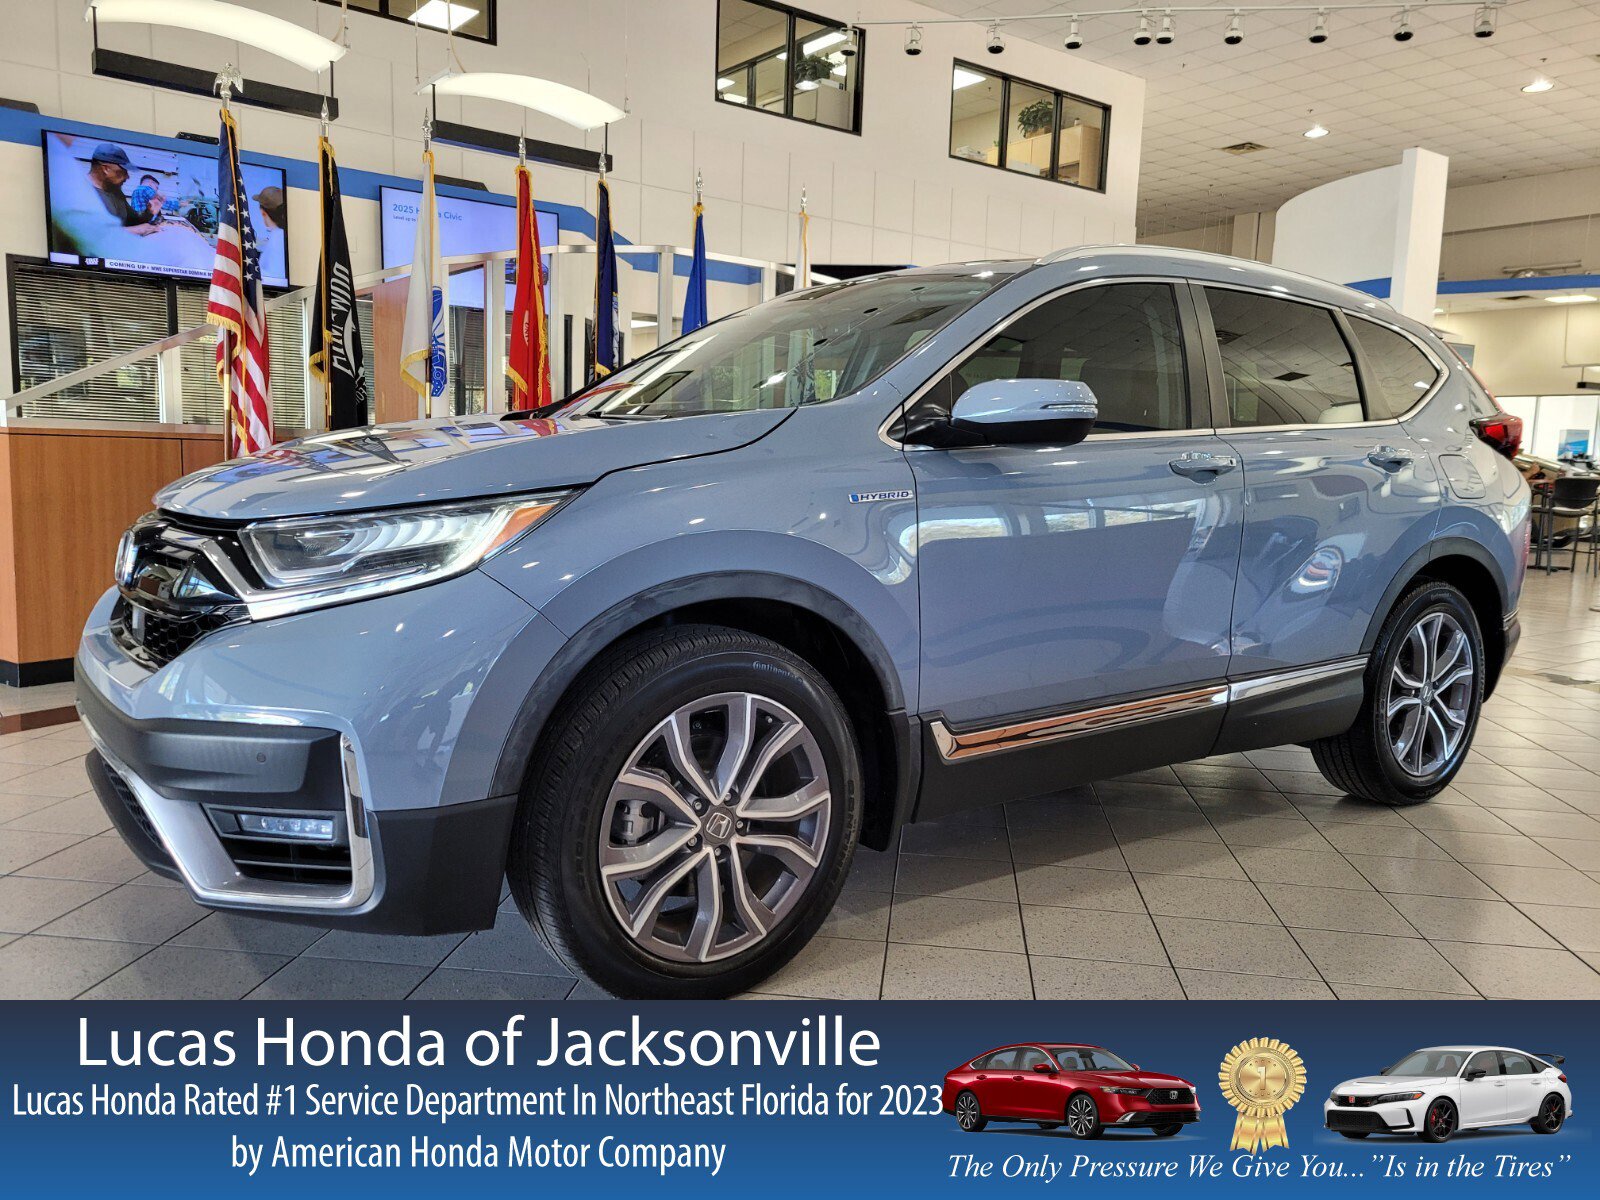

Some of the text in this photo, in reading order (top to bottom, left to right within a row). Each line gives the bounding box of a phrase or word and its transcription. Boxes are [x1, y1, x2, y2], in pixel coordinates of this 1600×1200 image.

[393, 204, 413, 214] 2025
[444, 211, 462, 221] Civic
[109, 261, 136, 269] COMING
[861, 491, 909, 500] HYBRID
